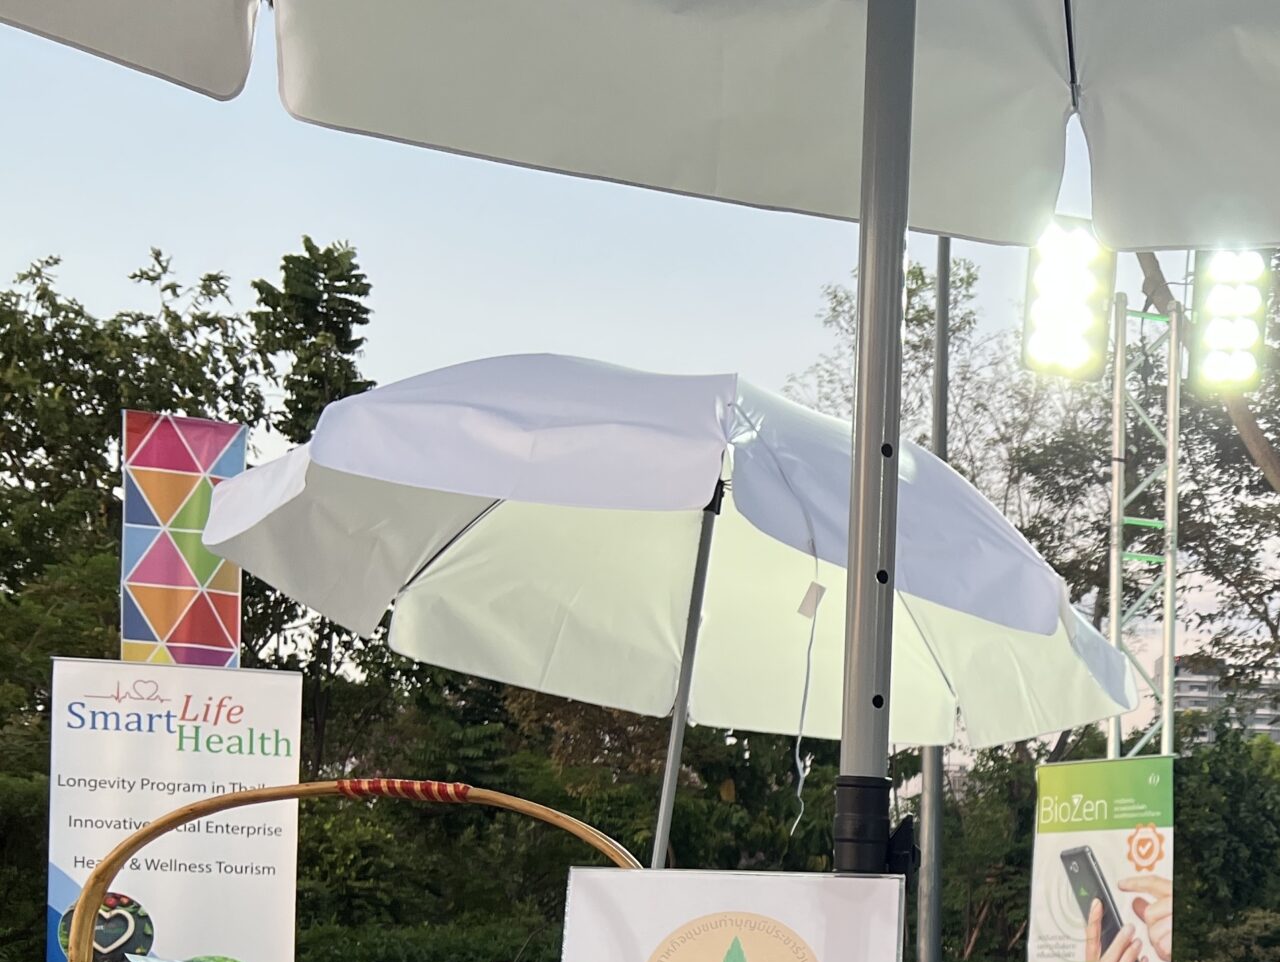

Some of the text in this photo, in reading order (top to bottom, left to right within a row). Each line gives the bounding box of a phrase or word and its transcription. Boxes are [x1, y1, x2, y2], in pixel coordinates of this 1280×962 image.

[66, 701, 177, 734] Smart
[178, 694, 245, 727] Life
[176, 724, 293, 757] Health
[57, 774, 136, 793] Longevity
[140, 778, 207, 795] Program
[212, 781, 226, 794] in
[1040, 793, 1108, 824] BioZen
[68, 815, 151, 832] Innovative
[206, 821, 283, 838] Enterprise
[129, 857, 141, 871] &
[145, 858, 212, 874] Wellness
[216, 861, 276, 876] Tourism
